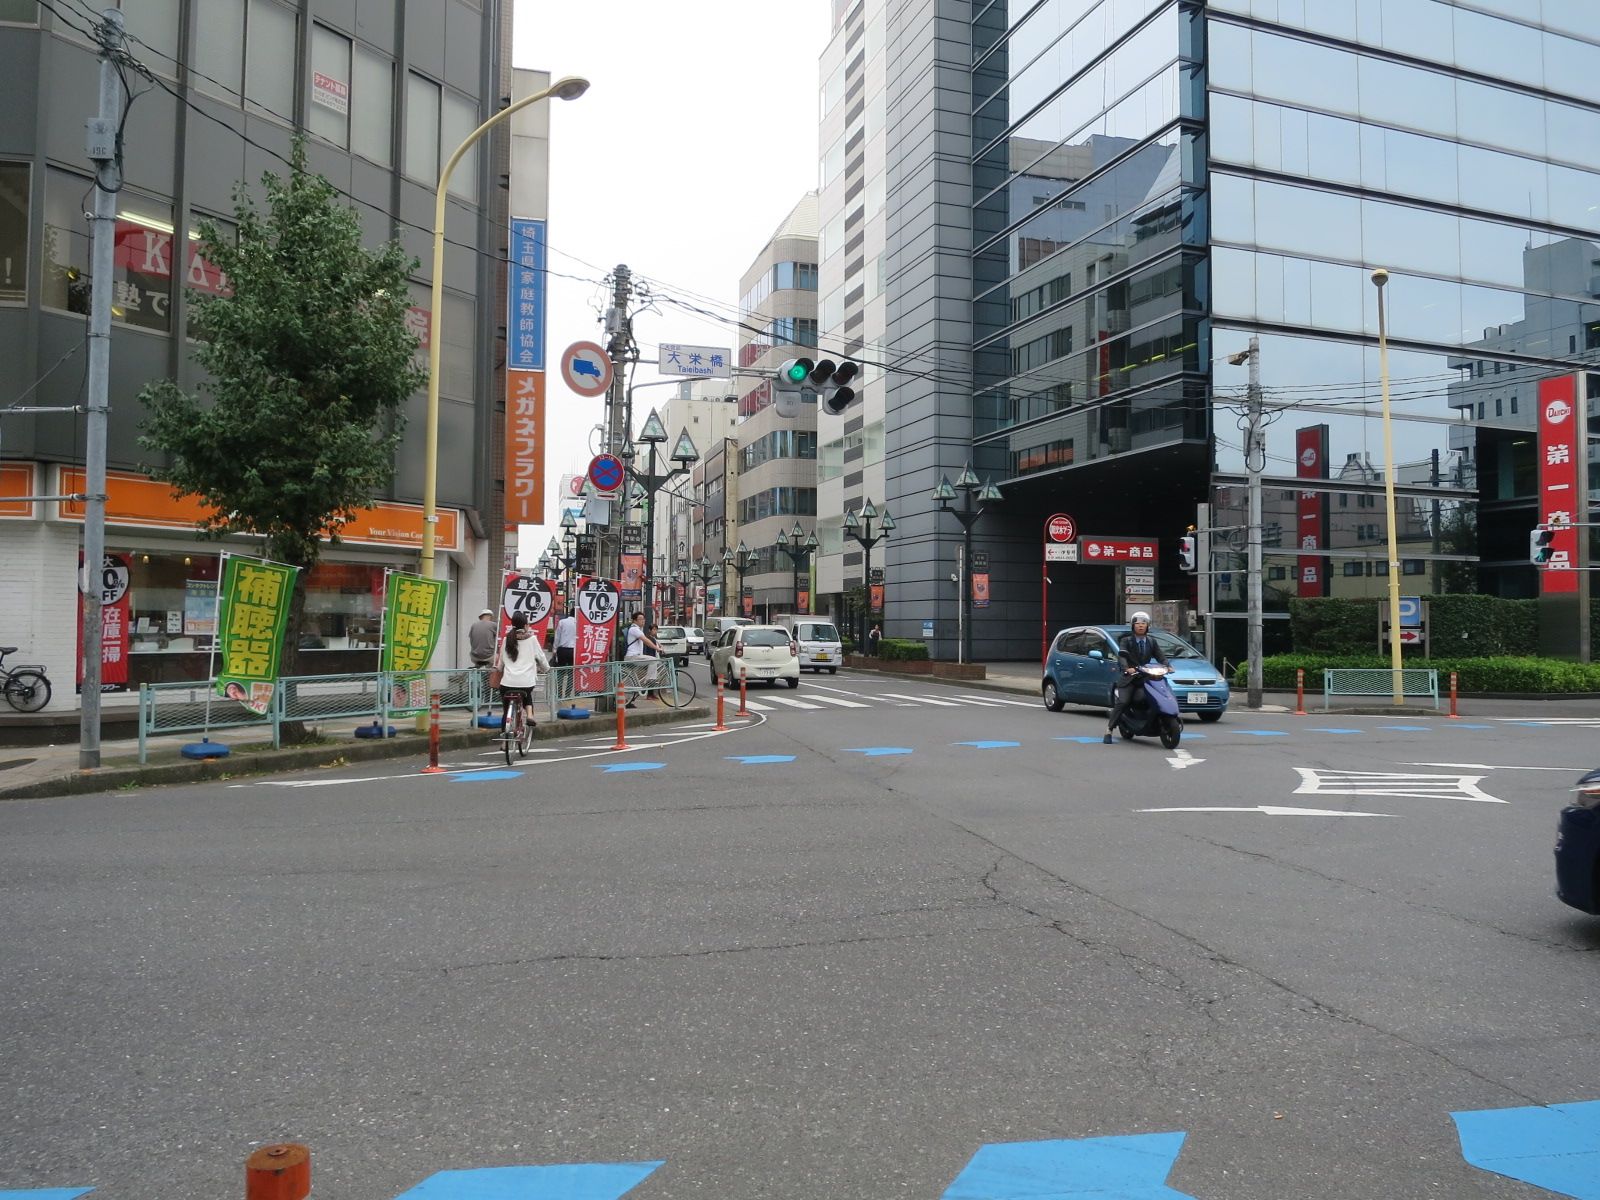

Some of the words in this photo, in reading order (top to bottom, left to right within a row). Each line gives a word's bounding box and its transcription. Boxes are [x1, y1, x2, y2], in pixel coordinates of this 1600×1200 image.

[519, 227, 536, 363] 埼玉県家庭教師協会
[667, 351, 723, 368] 大栄橋
[678, 365, 714, 375] Taieibashi
[515, 376, 536, 518] メガネフラワー
[1546, 444, 1570, 569] 第一商品
[369, 527, 386, 536] Your
[410, 531, 444, 542] Conrge
[1103, 545, 1154, 558] 第一商品
[517, 579, 540, 591] 最大
[588, 581, 608, 592] 最大
[511, 590, 546, 612] 70%
[585, 592, 615, 612] 70%
[229, 566, 282, 676] 補聴器
[394, 580, 436, 673] 補聴器
[588, 611, 608, 621] OFF
[103, 606, 121, 664] 在庫一掃
[591, 626, 610, 673] 在庫一掃
